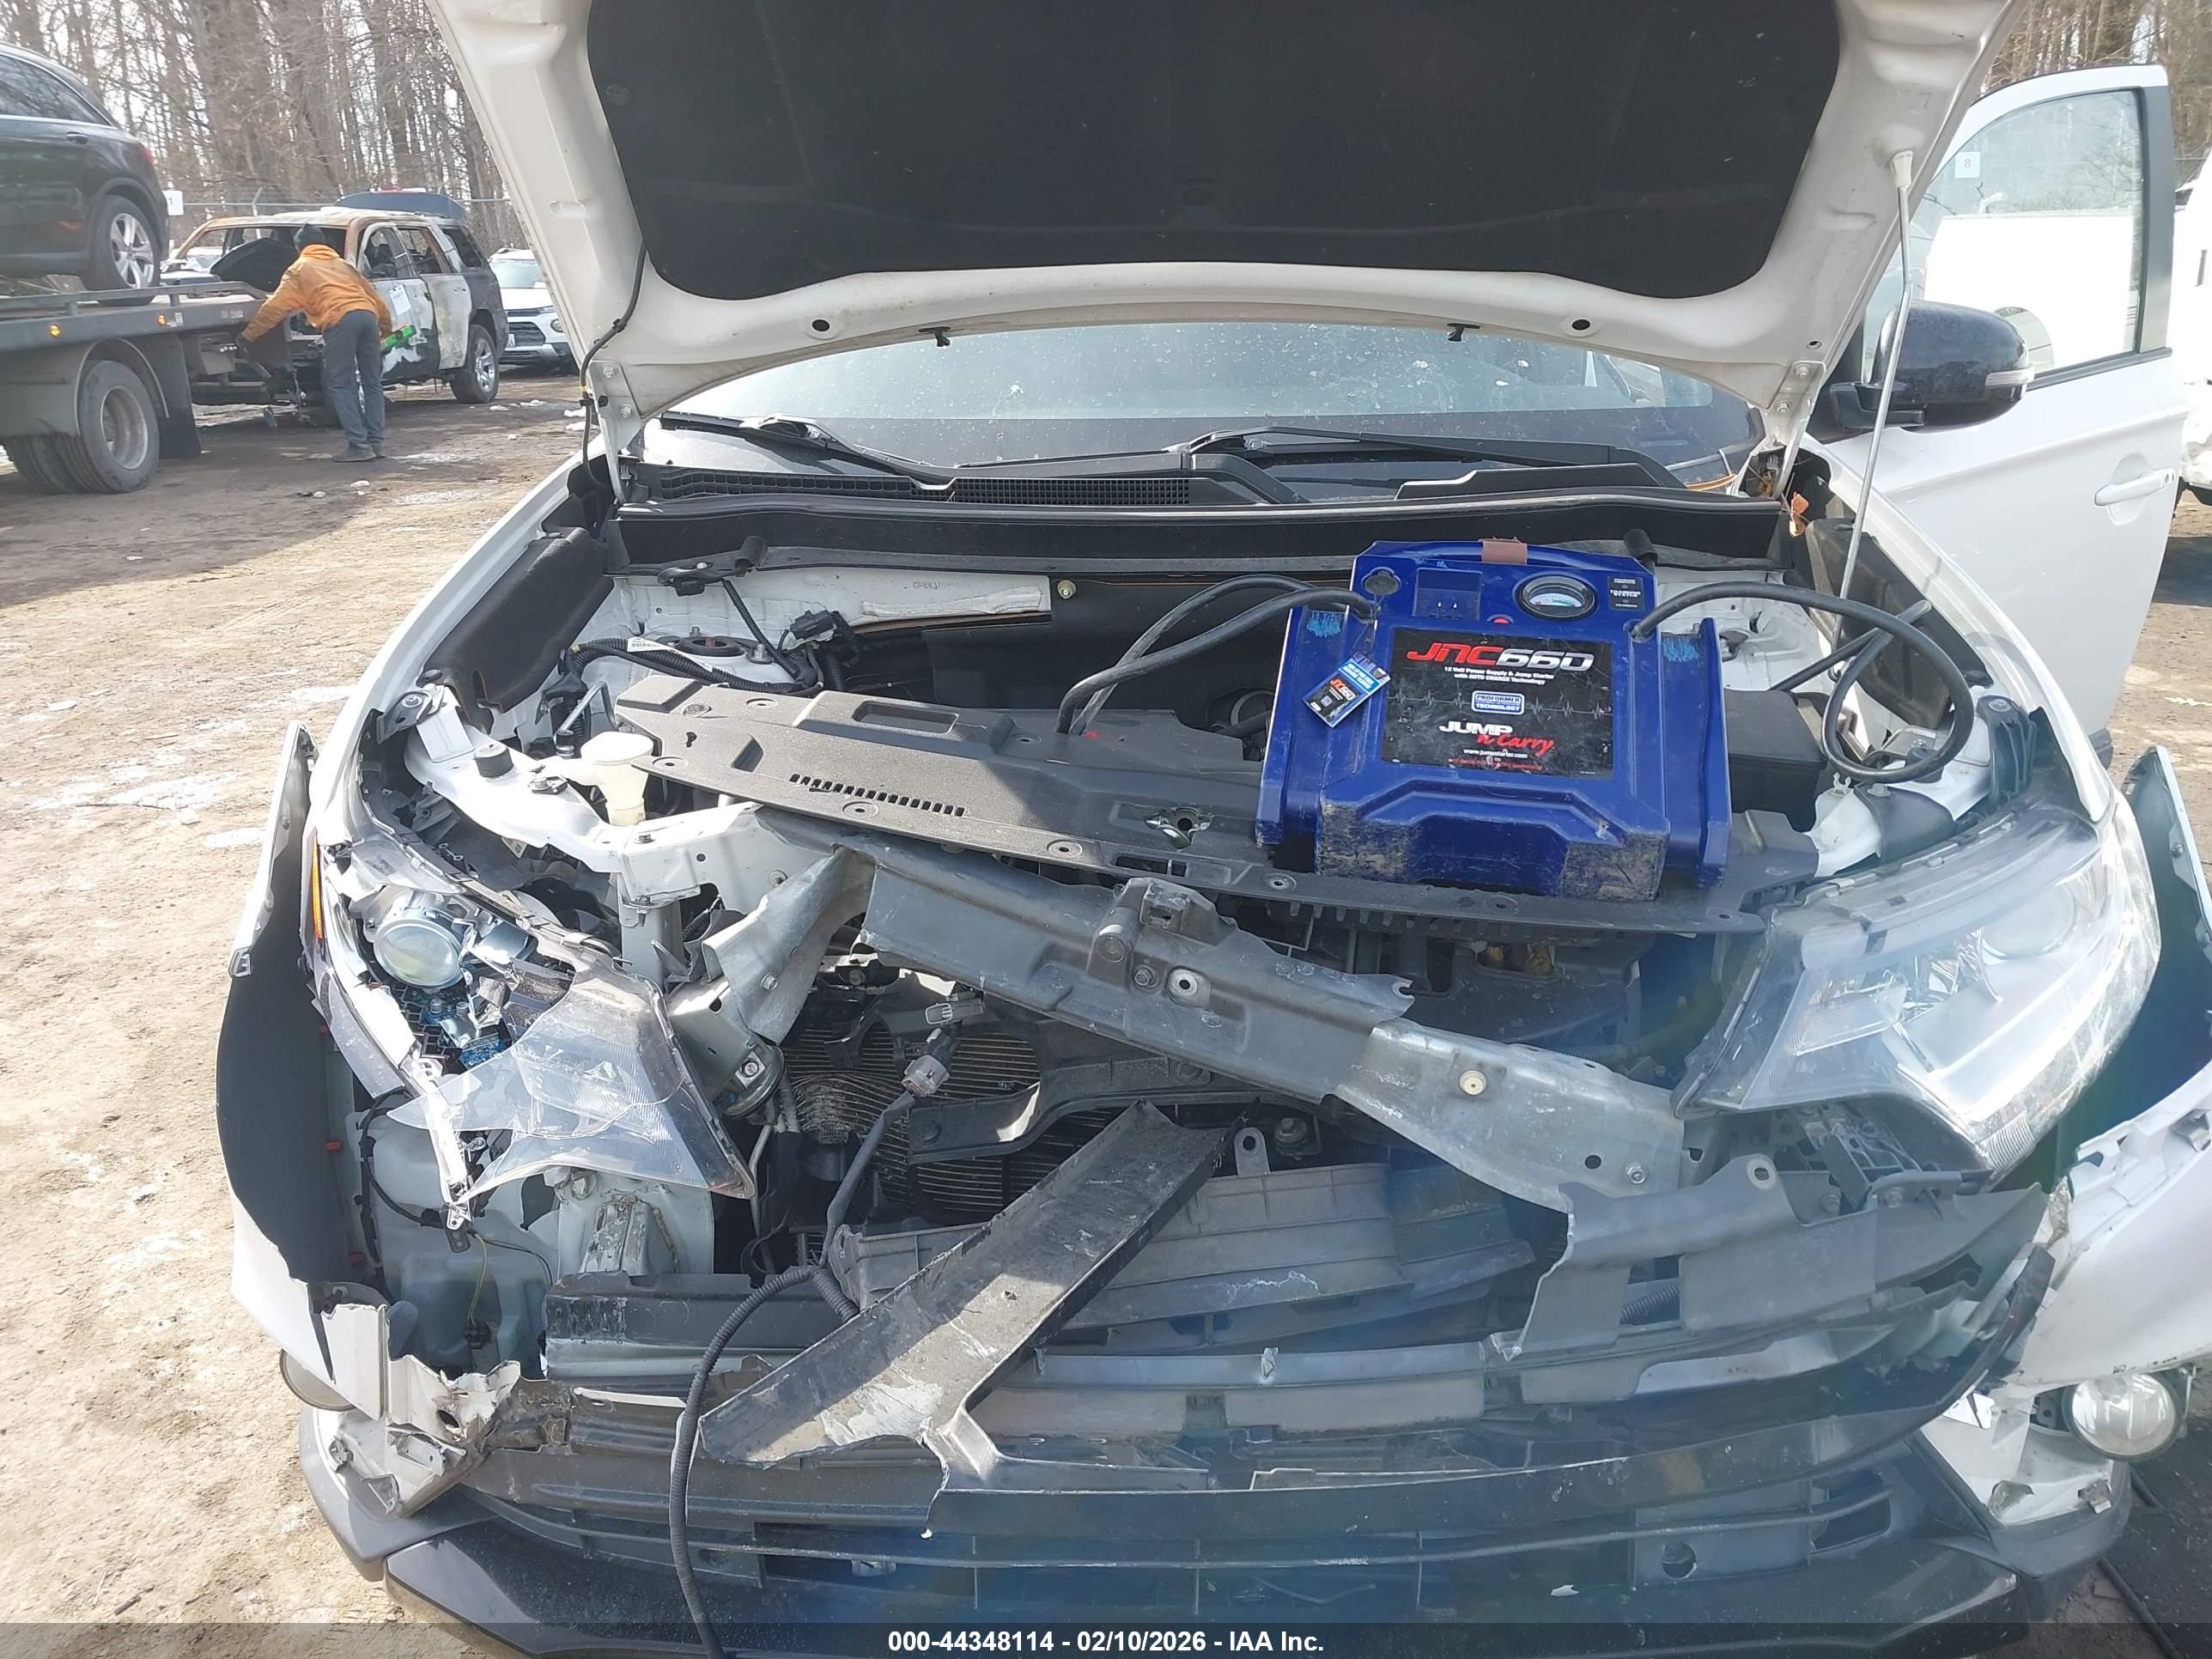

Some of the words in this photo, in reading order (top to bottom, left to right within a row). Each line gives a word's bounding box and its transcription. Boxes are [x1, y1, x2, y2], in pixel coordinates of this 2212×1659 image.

[1407, 642, 1595, 672] JNC660
[1439, 720, 1513, 736] JUMP
[1463, 748, 1528, 759] www.jumpstarter.com
[1497, 733, 1554, 757] Carry
